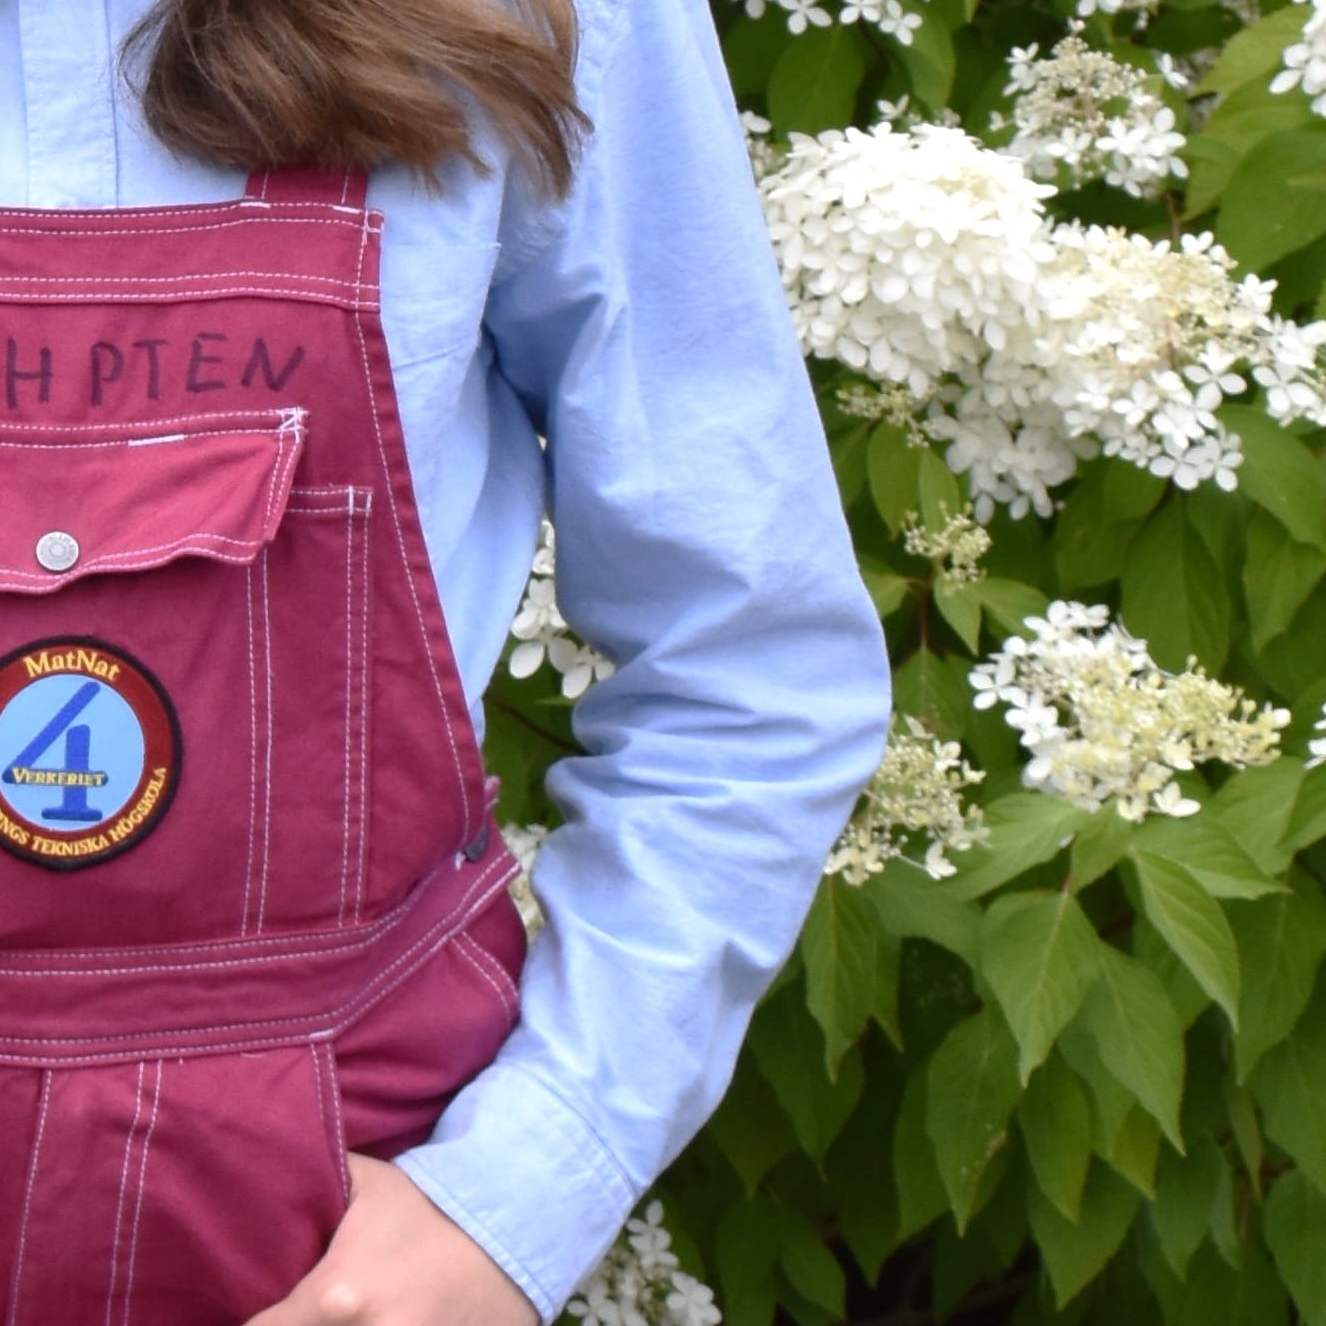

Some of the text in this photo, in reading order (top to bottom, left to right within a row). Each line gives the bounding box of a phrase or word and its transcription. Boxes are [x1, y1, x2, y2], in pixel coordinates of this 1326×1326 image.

[22, 649, 121, 681] MatNat
[31, 834, 111, 857] TEKNISKA
[107, 767, 167, 842] HÖGSKOLA
